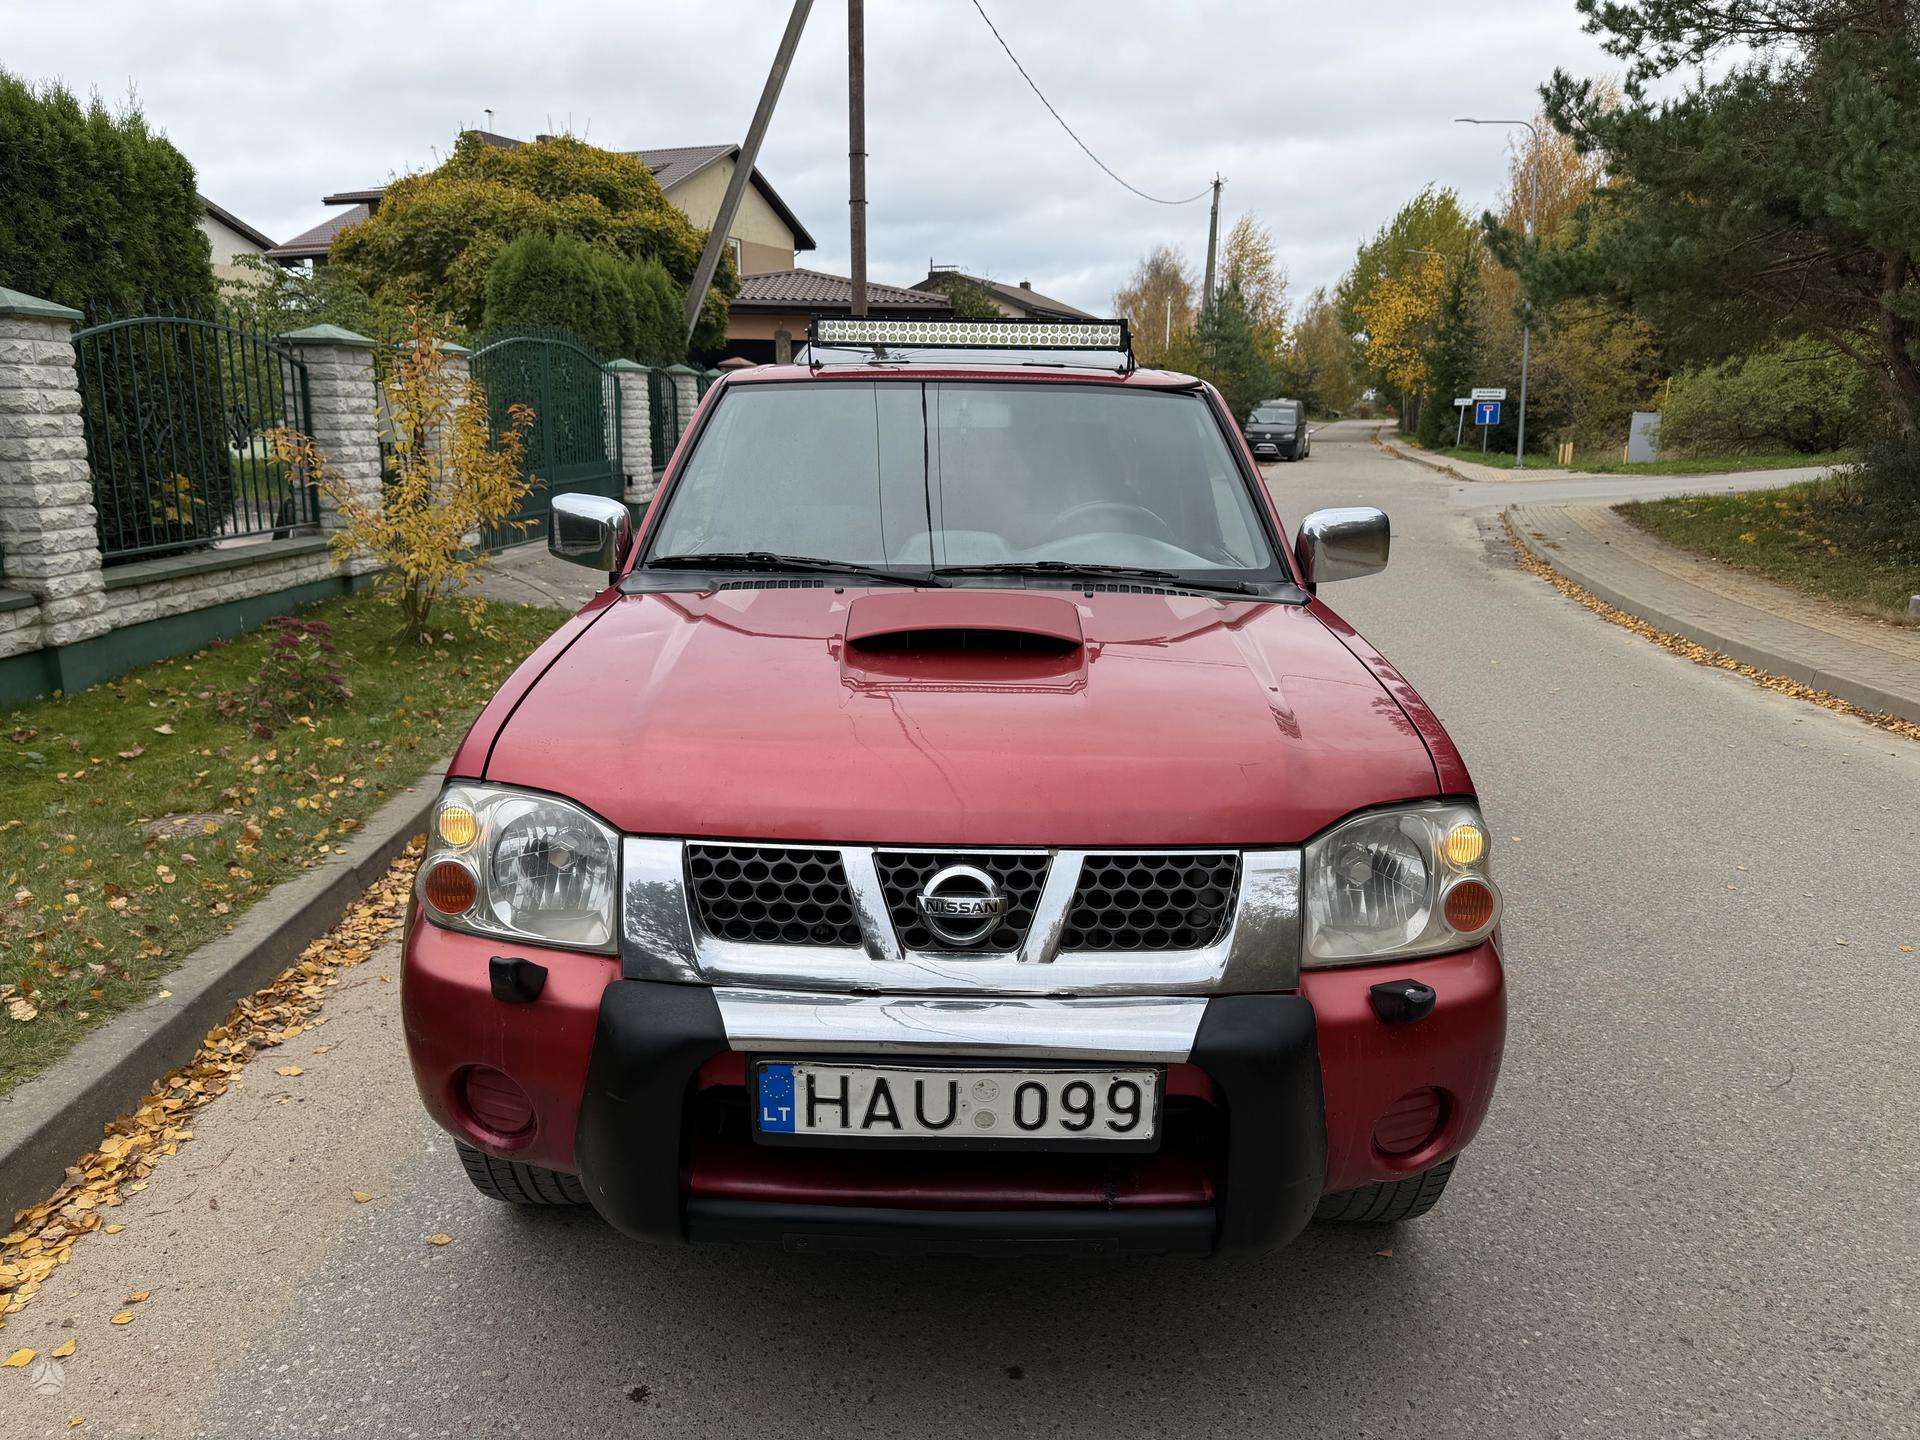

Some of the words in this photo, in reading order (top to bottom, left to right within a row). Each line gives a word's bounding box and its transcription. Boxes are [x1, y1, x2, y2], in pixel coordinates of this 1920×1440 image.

[925, 901, 998, 913] NISSAN
[805, 1073, 959, 1131] HAU
[1013, 1078, 1142, 1132] 099
[763, 1106, 791, 1122] LT
